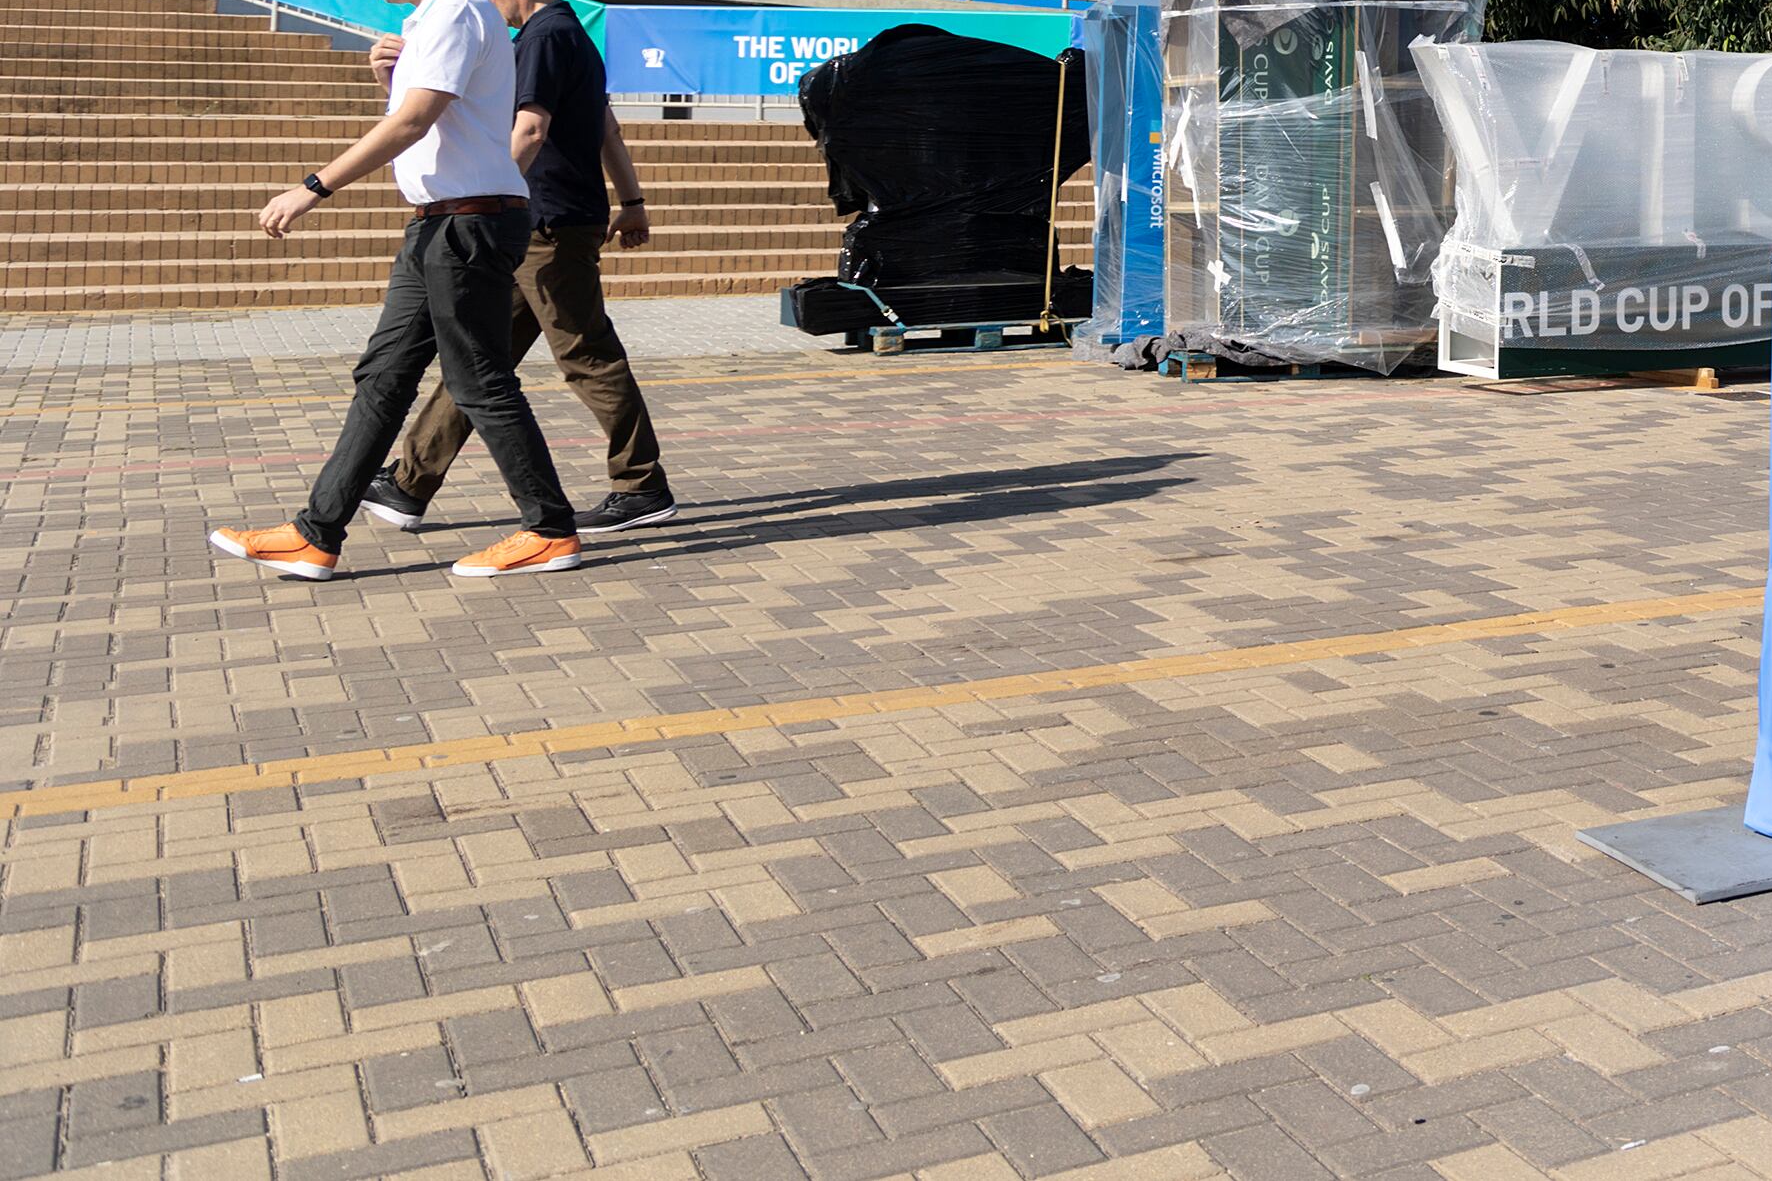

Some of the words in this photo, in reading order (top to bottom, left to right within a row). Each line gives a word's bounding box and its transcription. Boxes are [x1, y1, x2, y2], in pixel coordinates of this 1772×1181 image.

[733, 35, 785, 60] THE
[791, 36, 873, 59] WORL
[770, 61, 802, 85] OF
[1253, 53, 1269, 100] CUP
[1324, 40, 1334, 105] DAVIS
[1321, 187, 1330, 234] CUP
[1254, 236, 1270, 285] CUP
[1320, 241, 1330, 304] DAVIS
[1616, 284, 1710, 333] CUP
